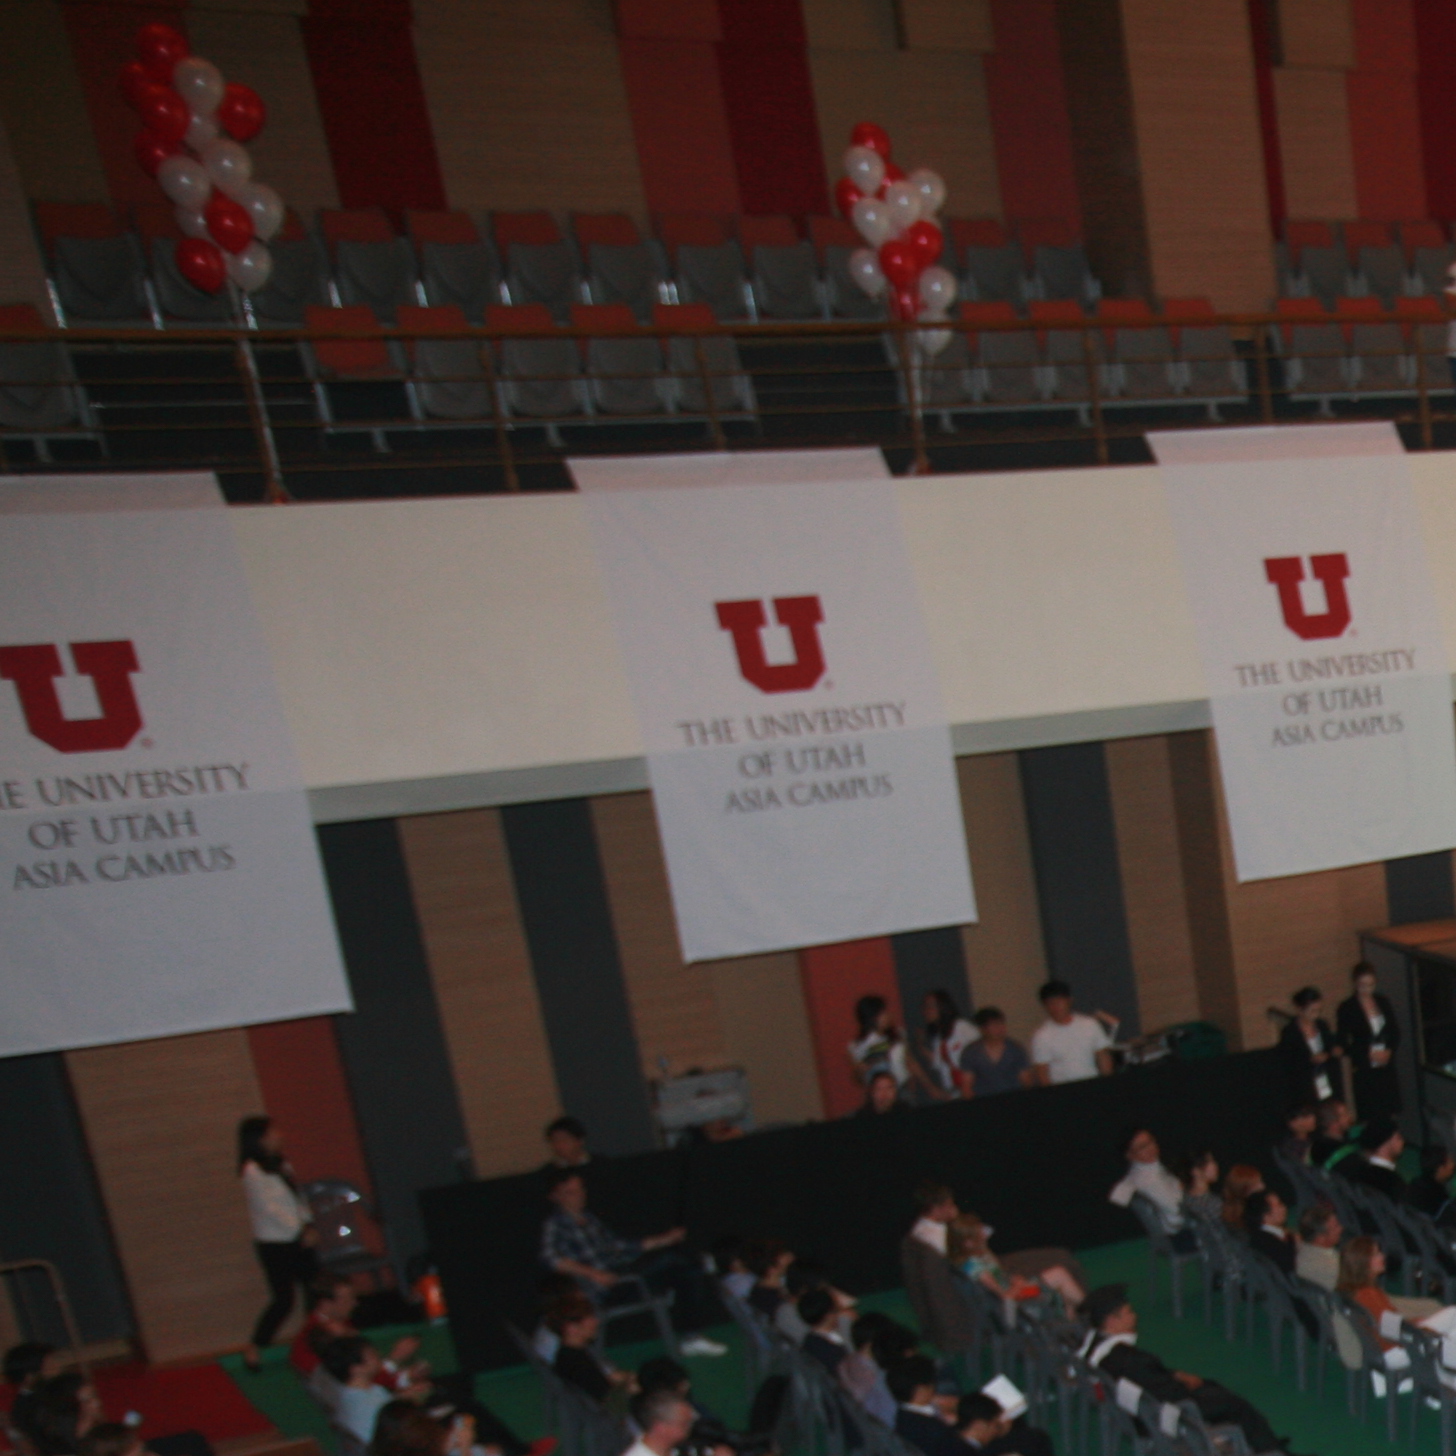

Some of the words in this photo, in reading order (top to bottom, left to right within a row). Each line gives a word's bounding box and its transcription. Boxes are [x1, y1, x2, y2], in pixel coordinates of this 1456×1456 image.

[1263, 552, 1353, 642] U
[714, 594, 827, 695] U
[1234, 661, 1282, 688] THE
[1287, 648, 1416, 682] UNIVERSITY
[0, 640, 144, 754] U
[1282, 690, 1313, 716] OF
[1318, 684, 1384, 714] UTAH
[678, 718, 737, 747] THE
[745, 701, 907, 741] UNIVERSITY
[1271, 724, 1316, 747] ASIA
[1320, 712, 1405, 742] CAMPUS
[737, 751, 777, 779] OF
[785, 742, 867, 774] UTAH
[36, 761, 250, 806] UNIVERSITY
[724, 787, 782, 814] ASIA
[786, 772, 895, 807] CAMPUS
[28, 820, 80, 850] OF
[91, 808, 200, 845] UTAH
[13, 860, 90, 891] ASIA
[96, 844, 237, 882] CAMPUS
